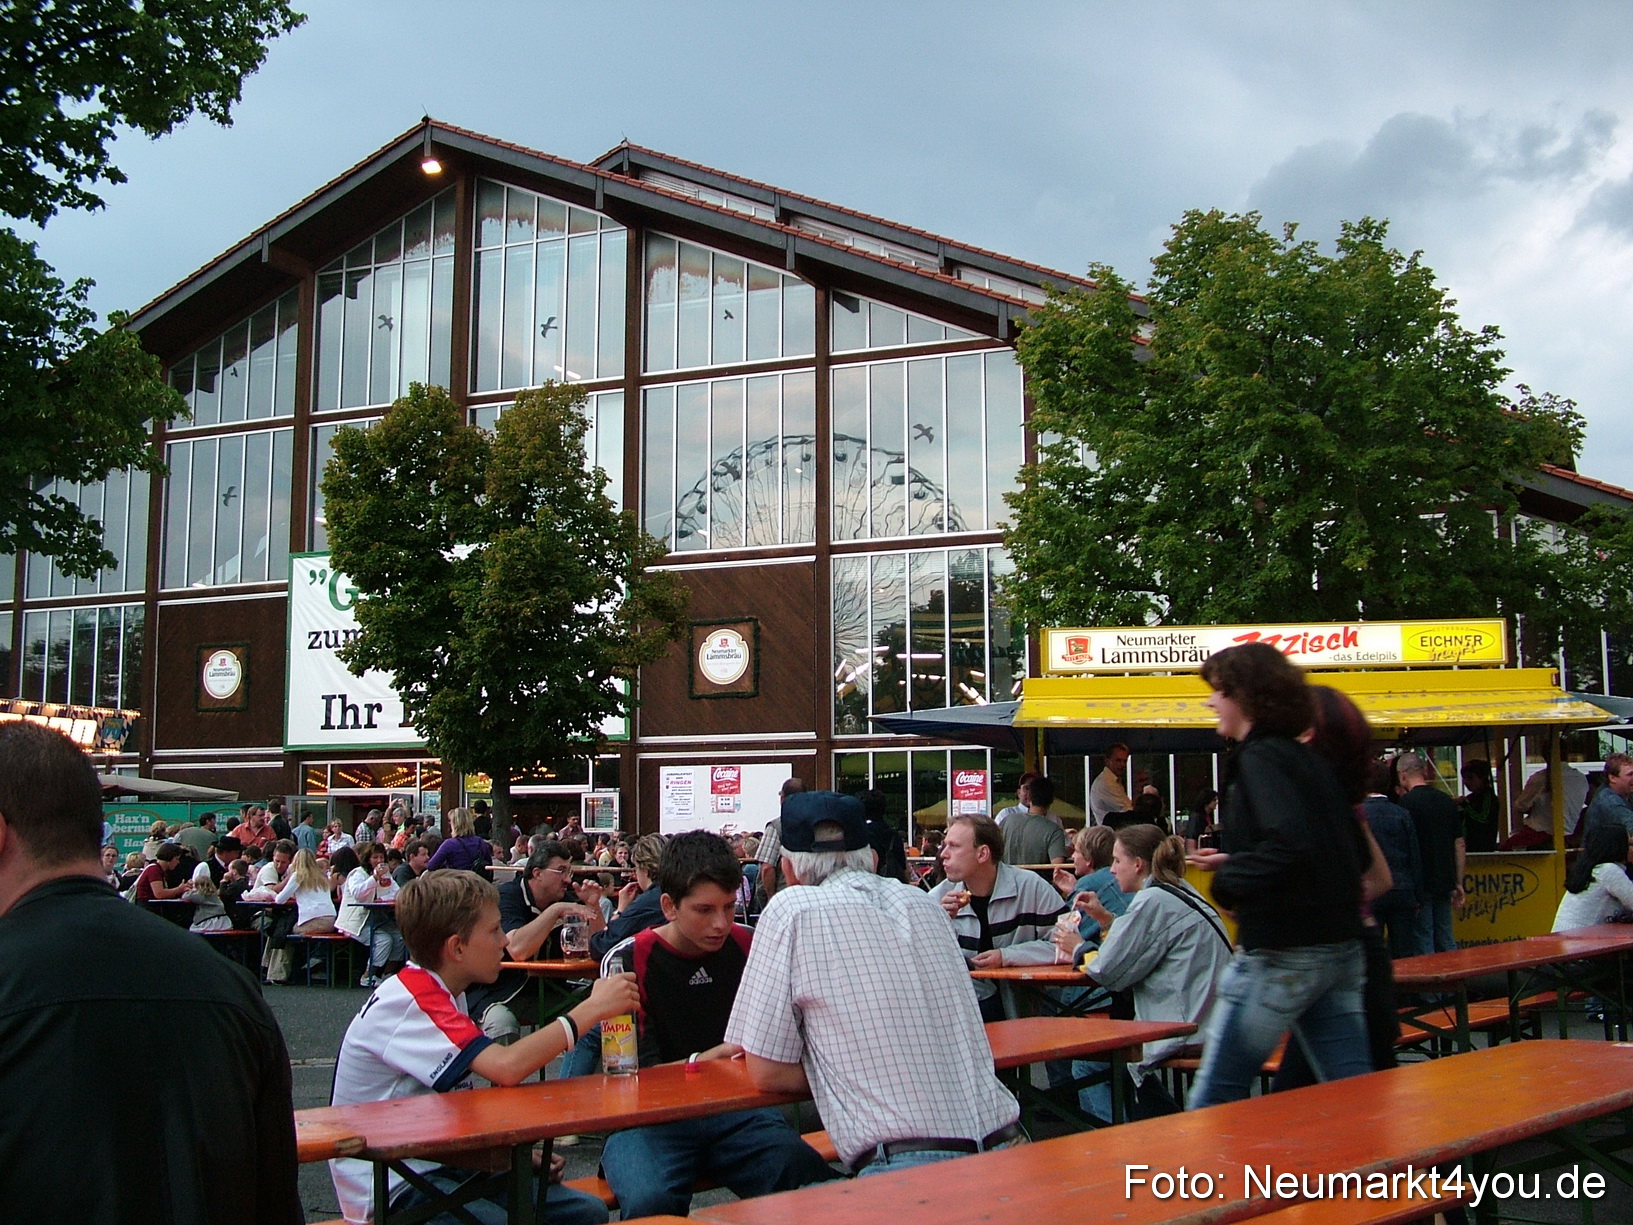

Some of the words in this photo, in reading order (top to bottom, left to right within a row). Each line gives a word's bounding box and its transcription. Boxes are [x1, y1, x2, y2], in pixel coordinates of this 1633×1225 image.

[1116, 633, 1197, 647] Neumarkter
[1420, 635, 1483, 647] EICHNER
[706, 652, 742, 661] Lammsbräu
[1101, 646, 1211, 664] Lammsbräu
[1356, 651, 1398, 663] Edelpils
[320, 693, 383, 730] Ihr
[114, 813, 150, 824] Hax'n
[1461, 872, 1525, 895] CHNER
[688, 975, 713, 986] adidas
[602, 1021, 632, 1033] YMPIA
[429, 1051, 453, 1080] ENGLAND
